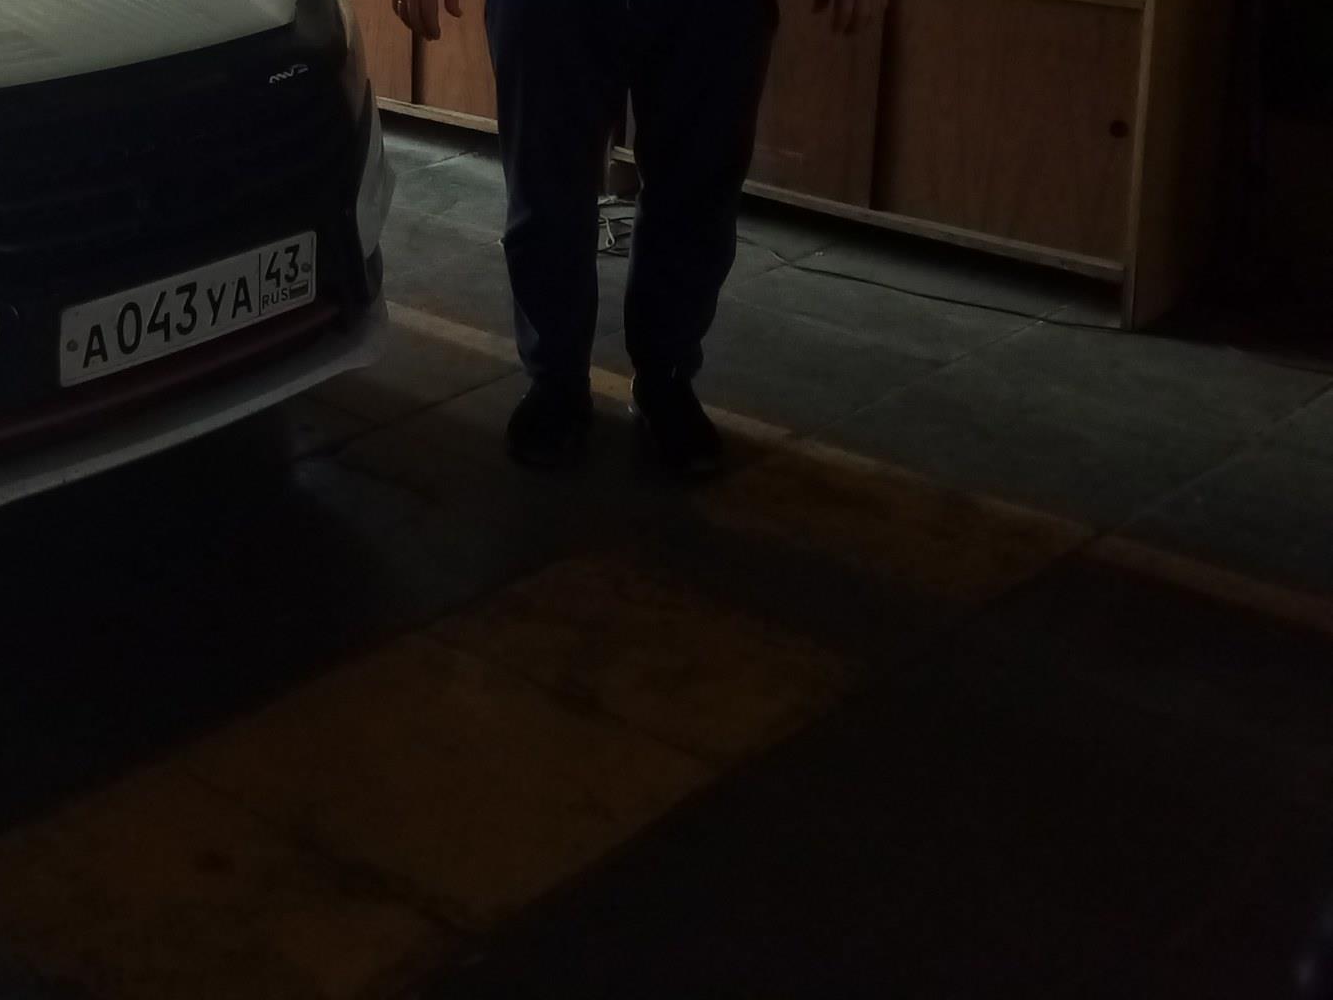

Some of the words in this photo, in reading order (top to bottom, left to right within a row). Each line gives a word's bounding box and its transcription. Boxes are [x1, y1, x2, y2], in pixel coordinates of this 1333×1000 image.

[83, 275, 253, 368] А043УА
[265, 244, 300, 288] 43
[262, 290, 289, 310] RUS
